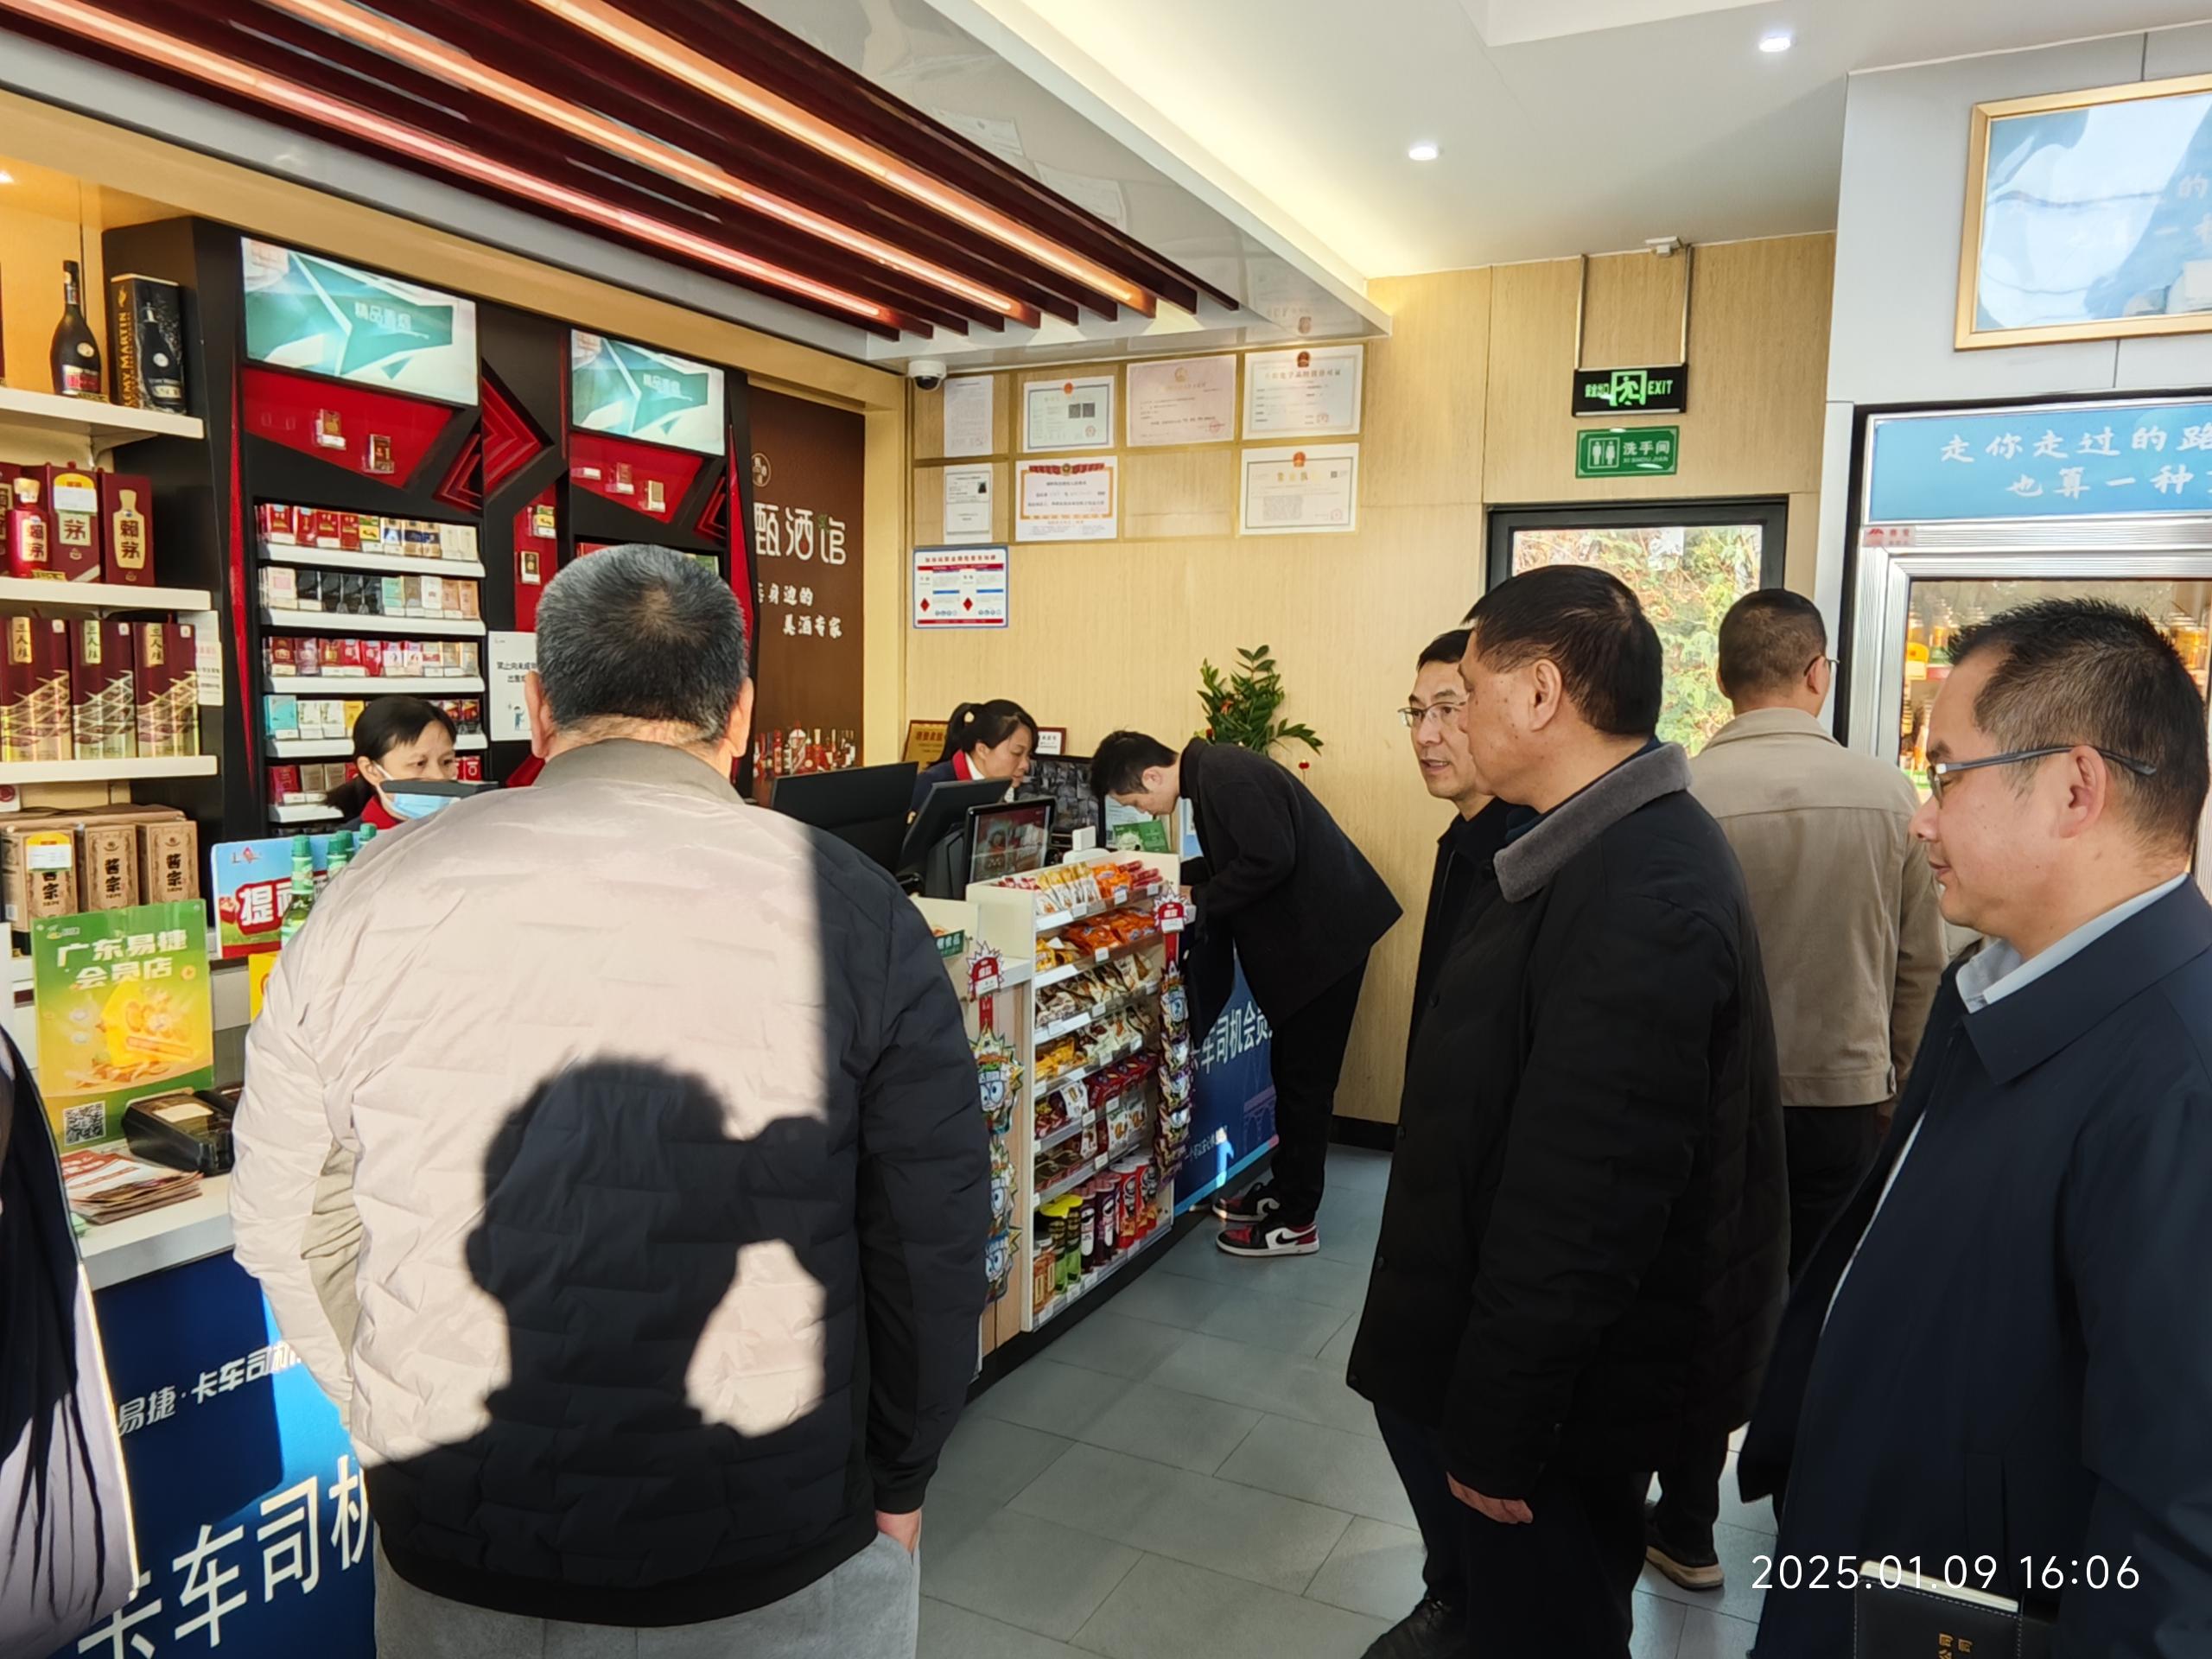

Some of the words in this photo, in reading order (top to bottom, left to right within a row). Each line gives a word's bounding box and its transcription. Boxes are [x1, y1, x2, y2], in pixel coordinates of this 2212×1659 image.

[1647, 379, 1673, 395] EXIT
[1623, 440, 1670, 455] 洗手间
[1941, 421, 2212, 462] 走你走过的路
[2005, 464, 2212, 499] 也算一种
[783, 613, 842, 639] 美酒专家
[57, 928, 188, 968] 广东易捷
[75, 957, 174, 990] 会员店
